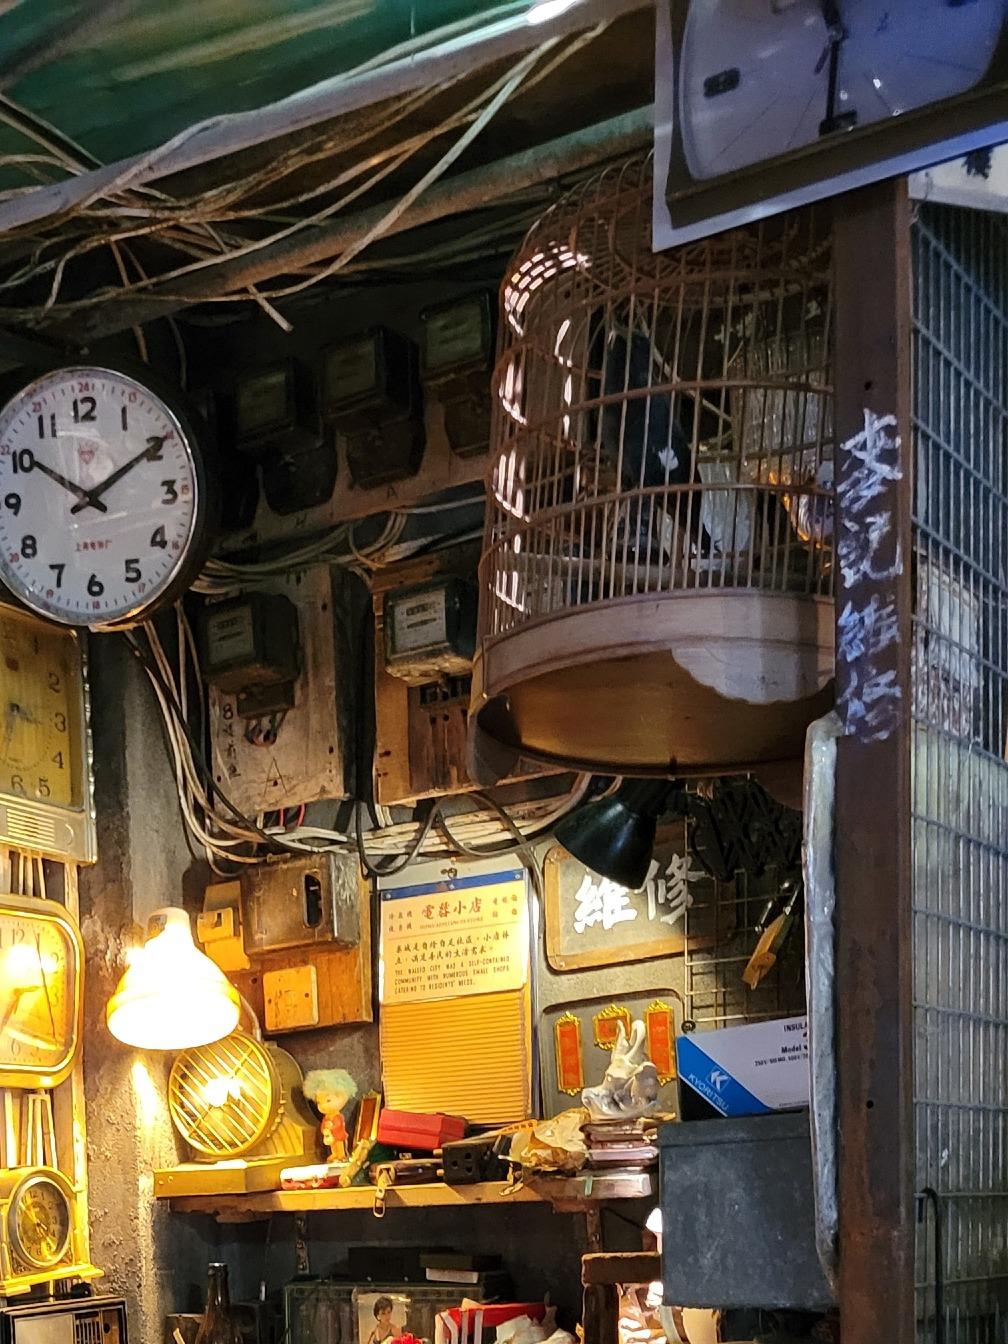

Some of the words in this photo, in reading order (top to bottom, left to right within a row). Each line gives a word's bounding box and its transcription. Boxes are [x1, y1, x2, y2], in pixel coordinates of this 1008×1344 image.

[72, 396, 97, 424] 12
[121, 405, 128, 432] 1
[37, 413, 57, 440] 11
[11, 448, 34, 474] 10
[145, 436, 163, 462] 2
[4, 492, 22, 517] 9
[160, 479, 178, 505] 3
[20, 534, 37, 560] 8
[150, 524, 168, 550] 4
[49, 563, 66, 588] 7
[124, 558, 142, 583] 5
[87, 573, 104, 598] 6
[48, 672, 61, 694] 2
[54, 712, 66, 733] 3
[52, 751, 64, 770] 4
[11, 775, 24, 792] 6
[38, 777, 51, 797] 5
[574, 853, 705, 933] 維修
[11, 928, 25, 945] 12
[688, 1073, 730, 1111] KYORITSU
